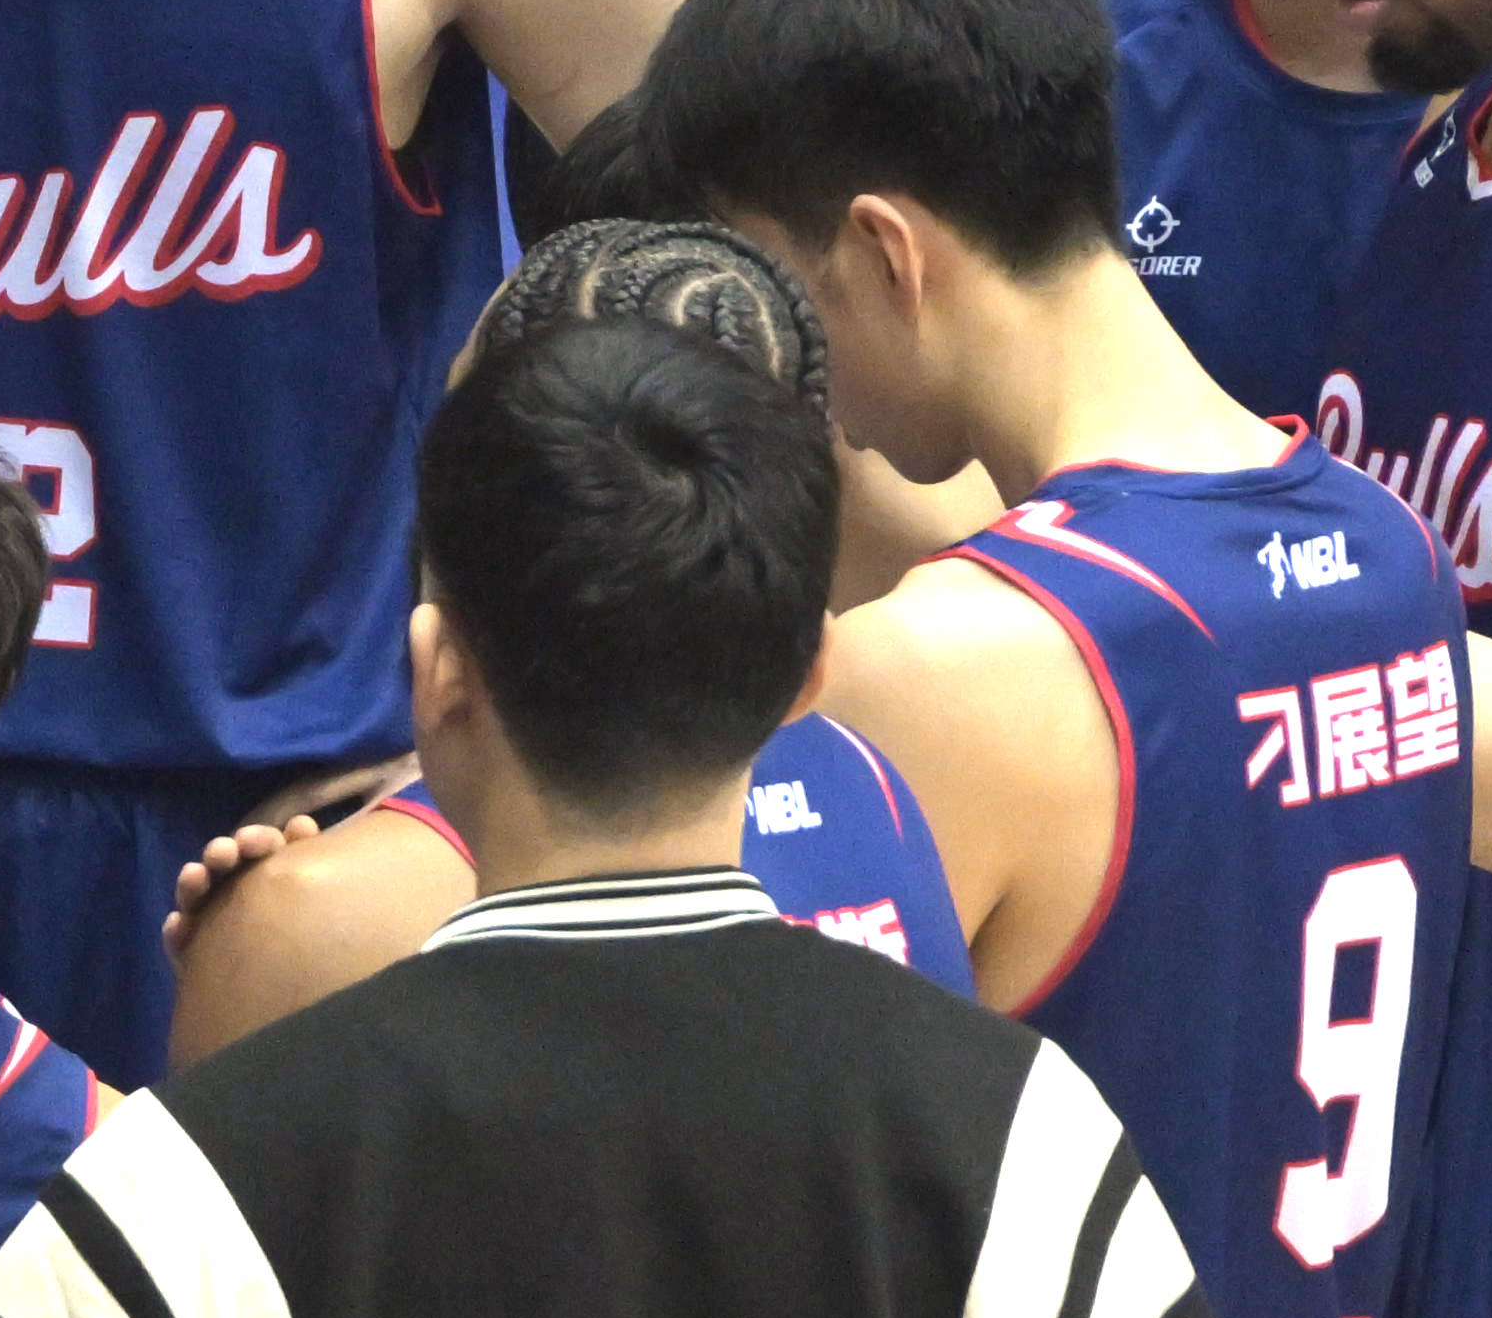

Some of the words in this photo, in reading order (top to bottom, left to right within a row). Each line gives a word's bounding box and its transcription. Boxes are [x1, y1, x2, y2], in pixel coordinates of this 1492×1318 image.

[1290, 530, 1361, 590] NBL
[1236, 638, 1460, 809] 刁展望
[752, 779, 823, 836] NBL
[1272, 853, 1418, 1271] 9
